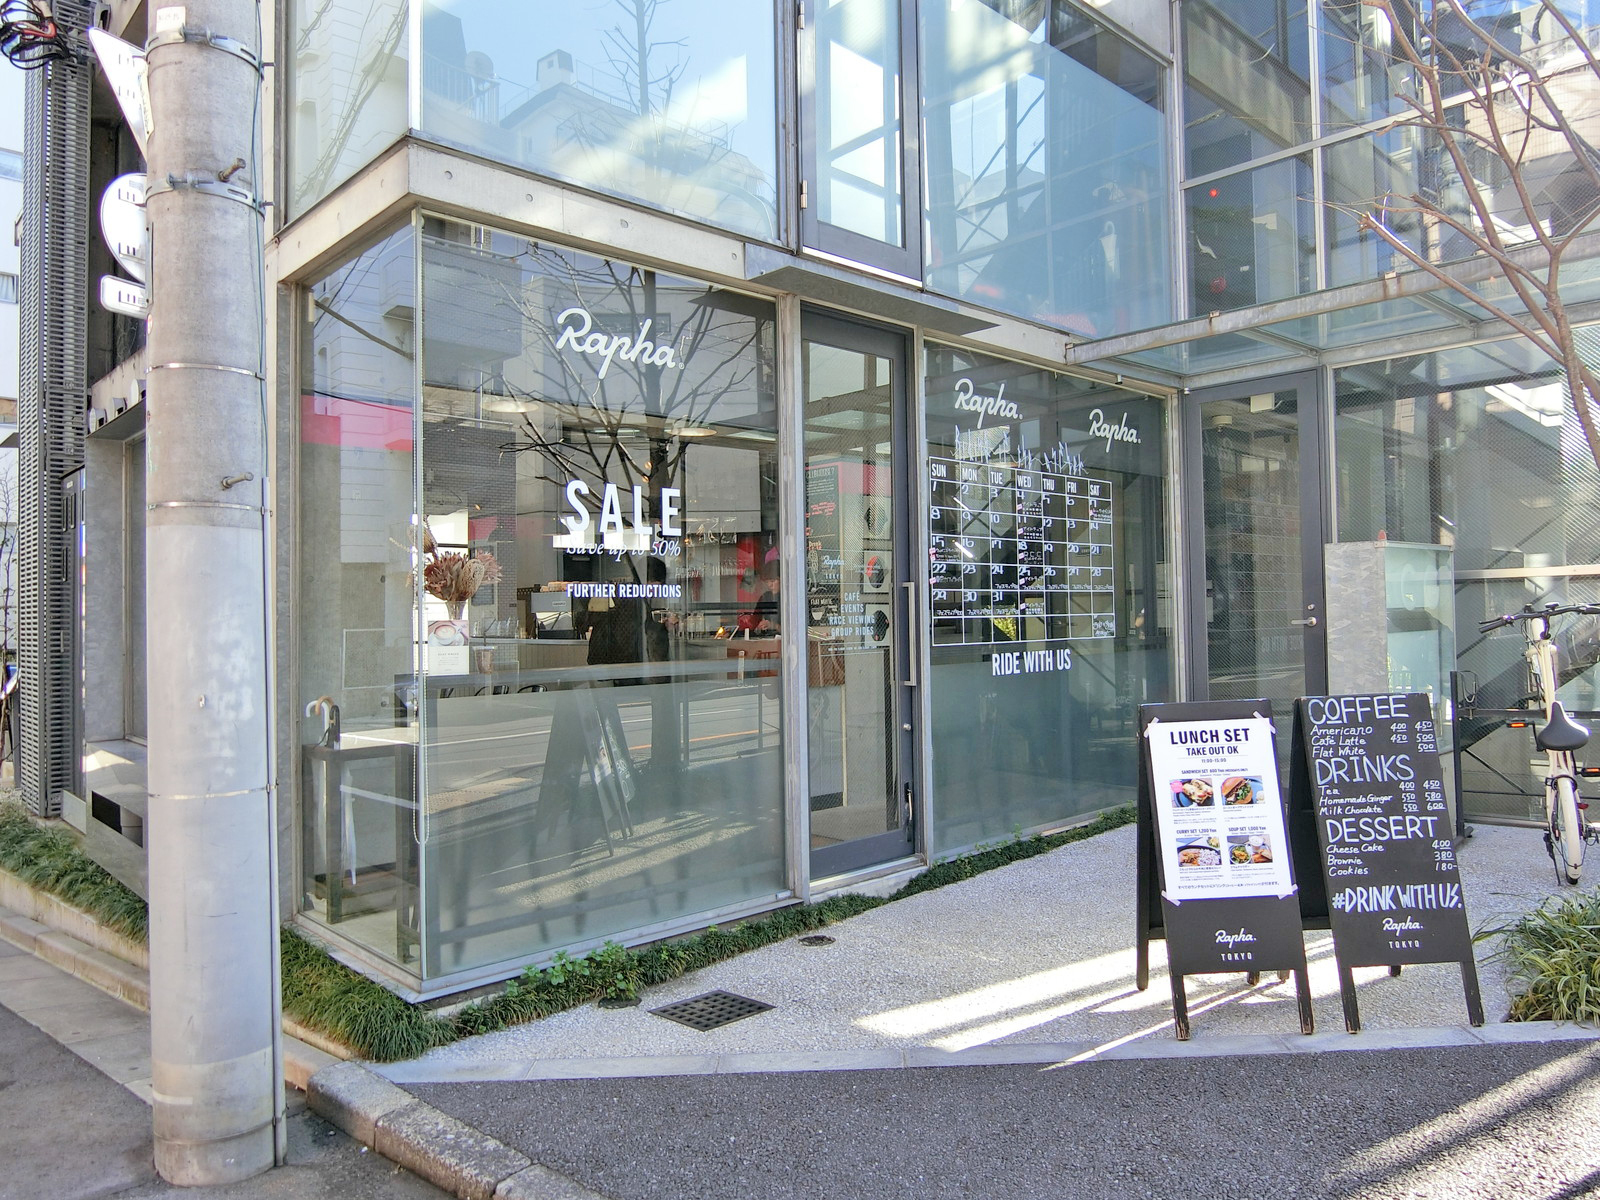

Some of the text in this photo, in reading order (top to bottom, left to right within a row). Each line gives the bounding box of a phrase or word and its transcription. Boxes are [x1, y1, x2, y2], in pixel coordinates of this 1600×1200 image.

[931, 463, 1100, 497] SUN MON TUE WED THU FRI SAT
[961, 484, 969, 495] 2
[990, 488, 999, 498] 3
[1017, 490, 1025, 500] 4
[1066, 496, 1075, 506] 6
[566, 479, 682, 537] SALE
[931, 507, 1099, 530] 8 9 10 11 12 13 14
[650, 540, 681, 557] 50%
[932, 536, 945, 547] 15
[962, 538, 975, 548] 16
[991, 539, 1002, 549] 17
[1018, 541, 1028, 550] 18
[1044, 543, 1053, 553] 19
[1068, 544, 1079, 553] 20
[1091, 545, 1100, 554] 21
[932, 563, 947, 573] 22
[962, 564, 977, 574] 23
[991, 565, 1004, 574] 24
[1018, 565, 1031, 576] 25
[1044, 566, 1056, 576] 26
[1091, 567, 1102, 577] 28
[567, 583, 682, 598] FURTHER REDUCTIONS
[844, 590, 860, 601] CAFÉ
[933, 590, 1003, 602] 29 30 31
[841, 603, 864, 613] EVENTS
[829, 615, 875, 626] RACE VIEWING
[831, 626, 874, 637] GROUP RIDES
[992, 648, 1072, 676] RIDE WITH US
[1308, 695, 1409, 725] COFFEE
[1310, 721, 1433, 736] Americano 400 450
[1170, 728, 1250, 745] LUNCH SET
[1339, 736, 1367, 746] Latte
[1390, 734, 1408, 743] 450
[1416, 733, 1435, 742] 500
[1186, 745, 1239, 756] TAKE OUT OK
[1312, 743, 1436, 758] Flat White 500
[1315, 754, 1414, 786] DRINKS
[1318, 780, 1441, 796] Tea 400 450
[1319, 791, 1443, 807] Homemade Ginger 550 580
[1320, 802, 1446, 816] Milk Chocolate 550 600
[1326, 815, 1438, 843] DESSERT
[1326, 839, 1451, 854] Cheese Cake 400
[1327, 851, 1454, 866] Brownie 380
[1328, 866, 1369, 877] Cookies
[1332, 882, 1463, 913] #DRINK WITH US.
[1388, 940, 1420, 949] TOKYO
[1220, 952, 1252, 961] TOKYO
